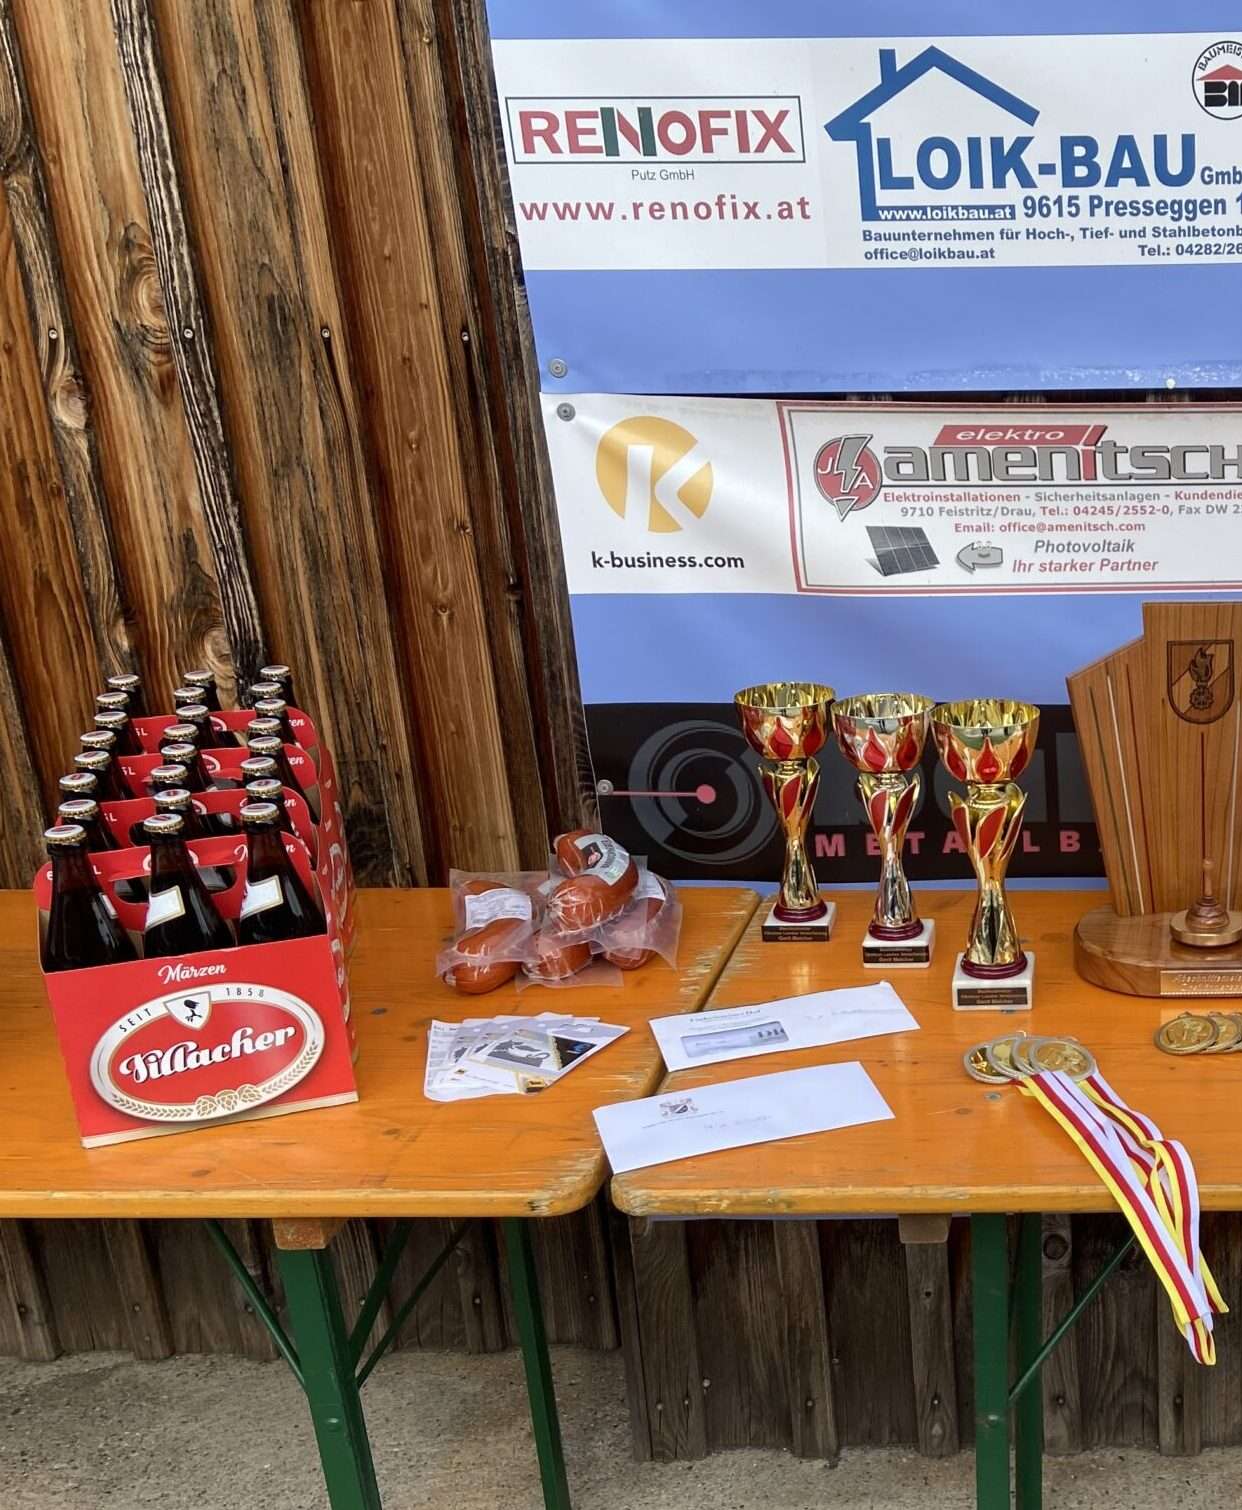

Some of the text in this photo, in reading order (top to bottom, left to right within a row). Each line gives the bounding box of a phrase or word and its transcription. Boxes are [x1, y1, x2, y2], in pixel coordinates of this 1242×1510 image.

[518, 107, 796, 157] RENOFIX
[876, 133, 1196, 191] LOIK-BAU
[631, 168, 695, 182] Putz GmbH
[519, 194, 812, 221] www.renofix.at
[877, 205, 1013, 221] www.loikbau.at
[1022, 195, 1081, 218] 9615
[1089, 194, 1227, 222] Presseggen
[862, 228, 994, 243] Bauunternehmen
[999, 227, 1022, 241] für
[1026, 227, 1075, 242] Hoch-,
[1079, 226, 1114, 239] Tief-
[1119, 227, 1147, 240] und
[864, 247, 995, 261] office@loikbau.at
[1138, 244, 1171, 257] Tel.:
[955, 427, 1065, 441] elektro
[883, 491, 1020, 504] Elektroinstallationen
[1034, 490, 1161, 504] Sicherheitsanlagen
[901, 506, 934, 517] 9710
[938, 505, 1036, 518] Feistritz/Drau,
[1040, 505, 1069, 517] Tel.:
[1072, 504, 1174, 518] 04245/2552-0,
[1178, 504, 1201, 515] Fax
[1205, 504, 1228, 515] DW
[954, 521, 1146, 534] Email: office@amenitsch.com
[1034, 539, 1135, 554] Photovoltaik
[591, 551, 745, 568] k-business.com
[1012, 557, 1159, 573] Ihr starker Partner
[158, 963, 227, 985] Märzen
[225, 986, 265, 998] 1858
[119, 1008, 152, 1033] SEIT
